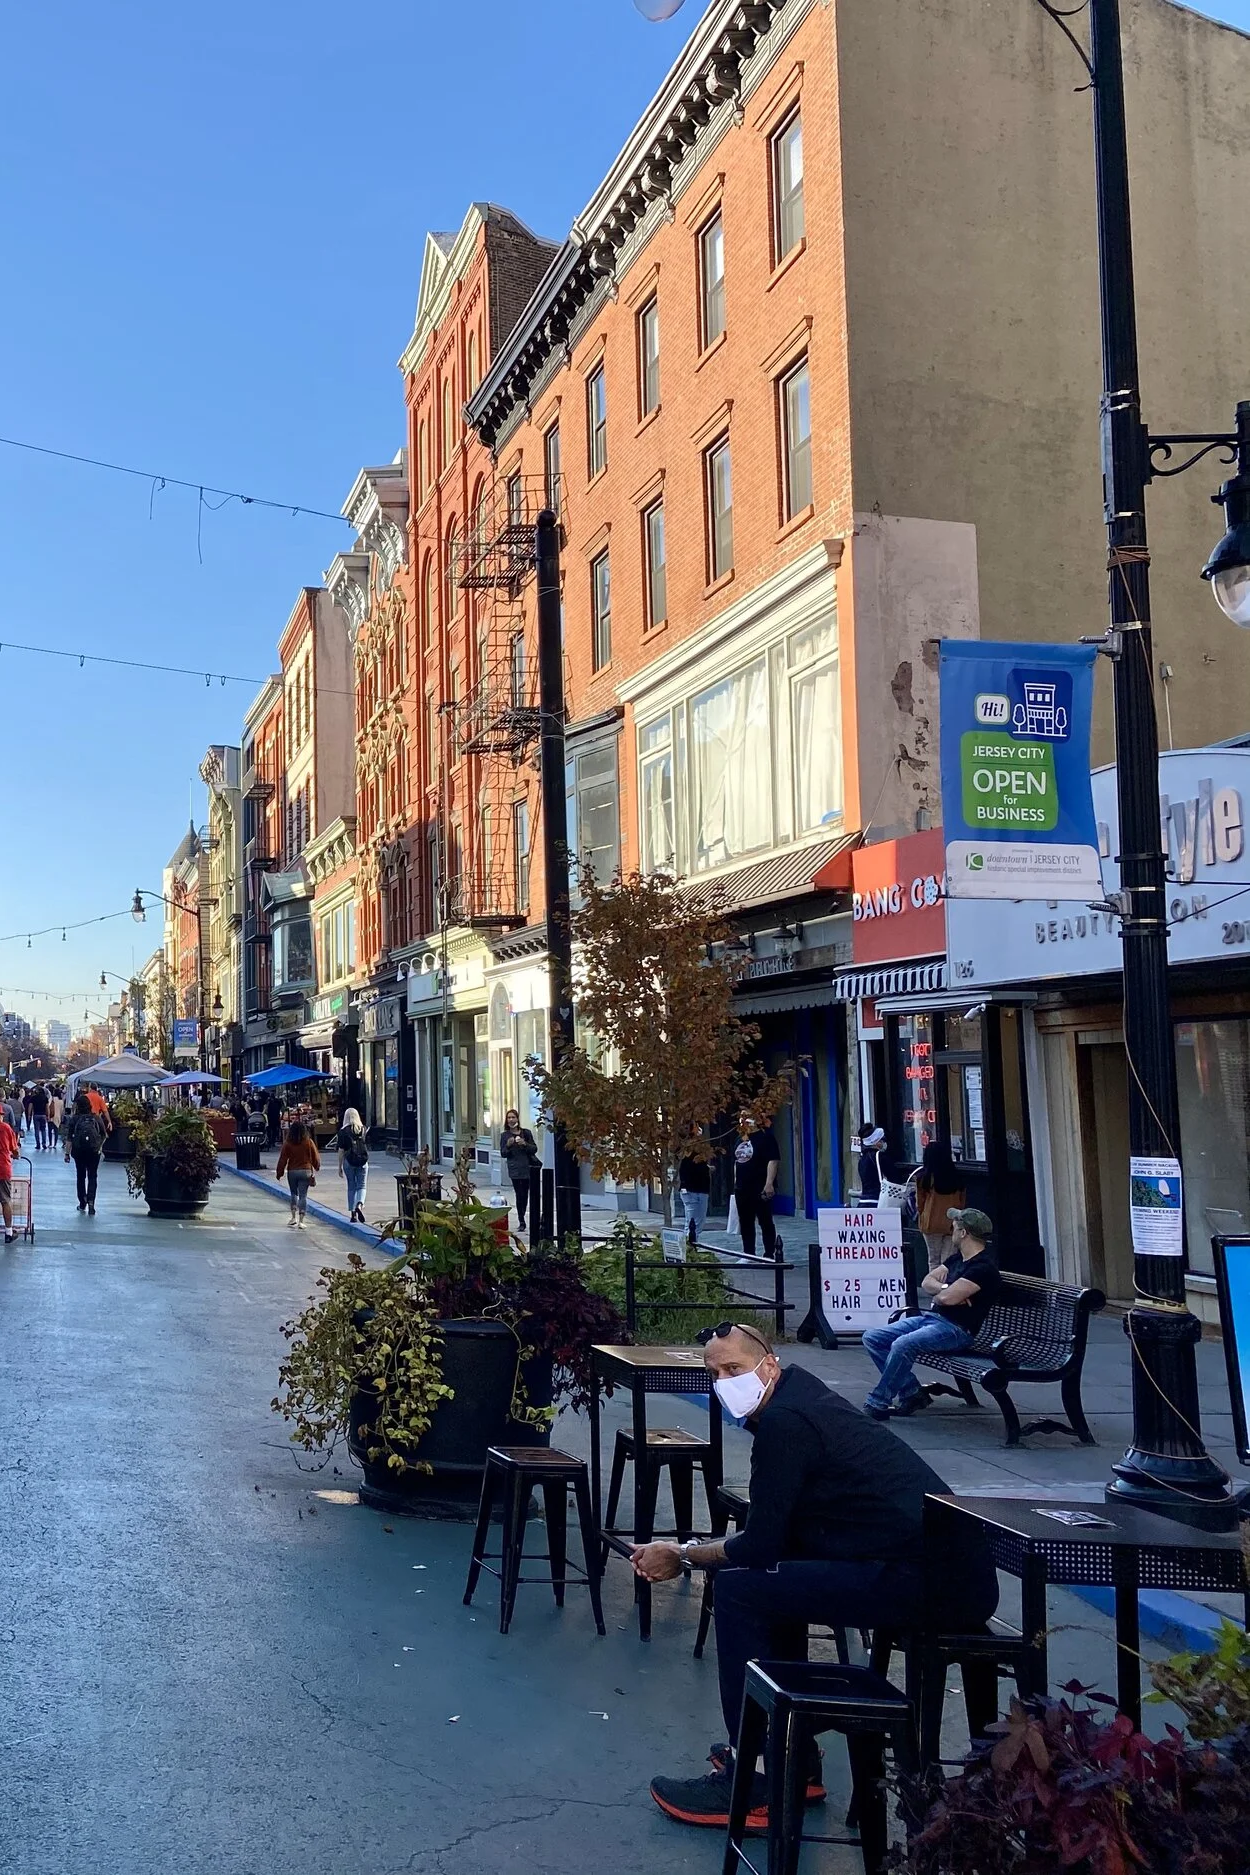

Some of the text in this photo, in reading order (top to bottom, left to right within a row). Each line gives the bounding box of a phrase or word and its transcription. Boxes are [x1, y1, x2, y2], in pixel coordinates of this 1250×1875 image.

[981, 702, 1004, 717] Hi!
[972, 746, 1046, 759] JERSEY CITY
[972, 769, 1047, 795] OPEN
[1003, 794, 1018, 805] for
[976, 807, 1045, 822] BUSINESS
[986, 854, 1080, 866] downtown JERSEY CITY
[852, 884, 901, 921] BANG
[1035, 912, 1114, 944] BEAUTY
[954, 960, 975, 979] 126
[844, 1214, 873, 1227] HAIR
[838, 1230, 886, 1243] WAXING
[827, 1246, 898, 1260] THREADING
[845, 1279, 861, 1292] 25
[879, 1279, 906, 1292] MEN
[832, 1295, 901, 1309] HAIR CUT
